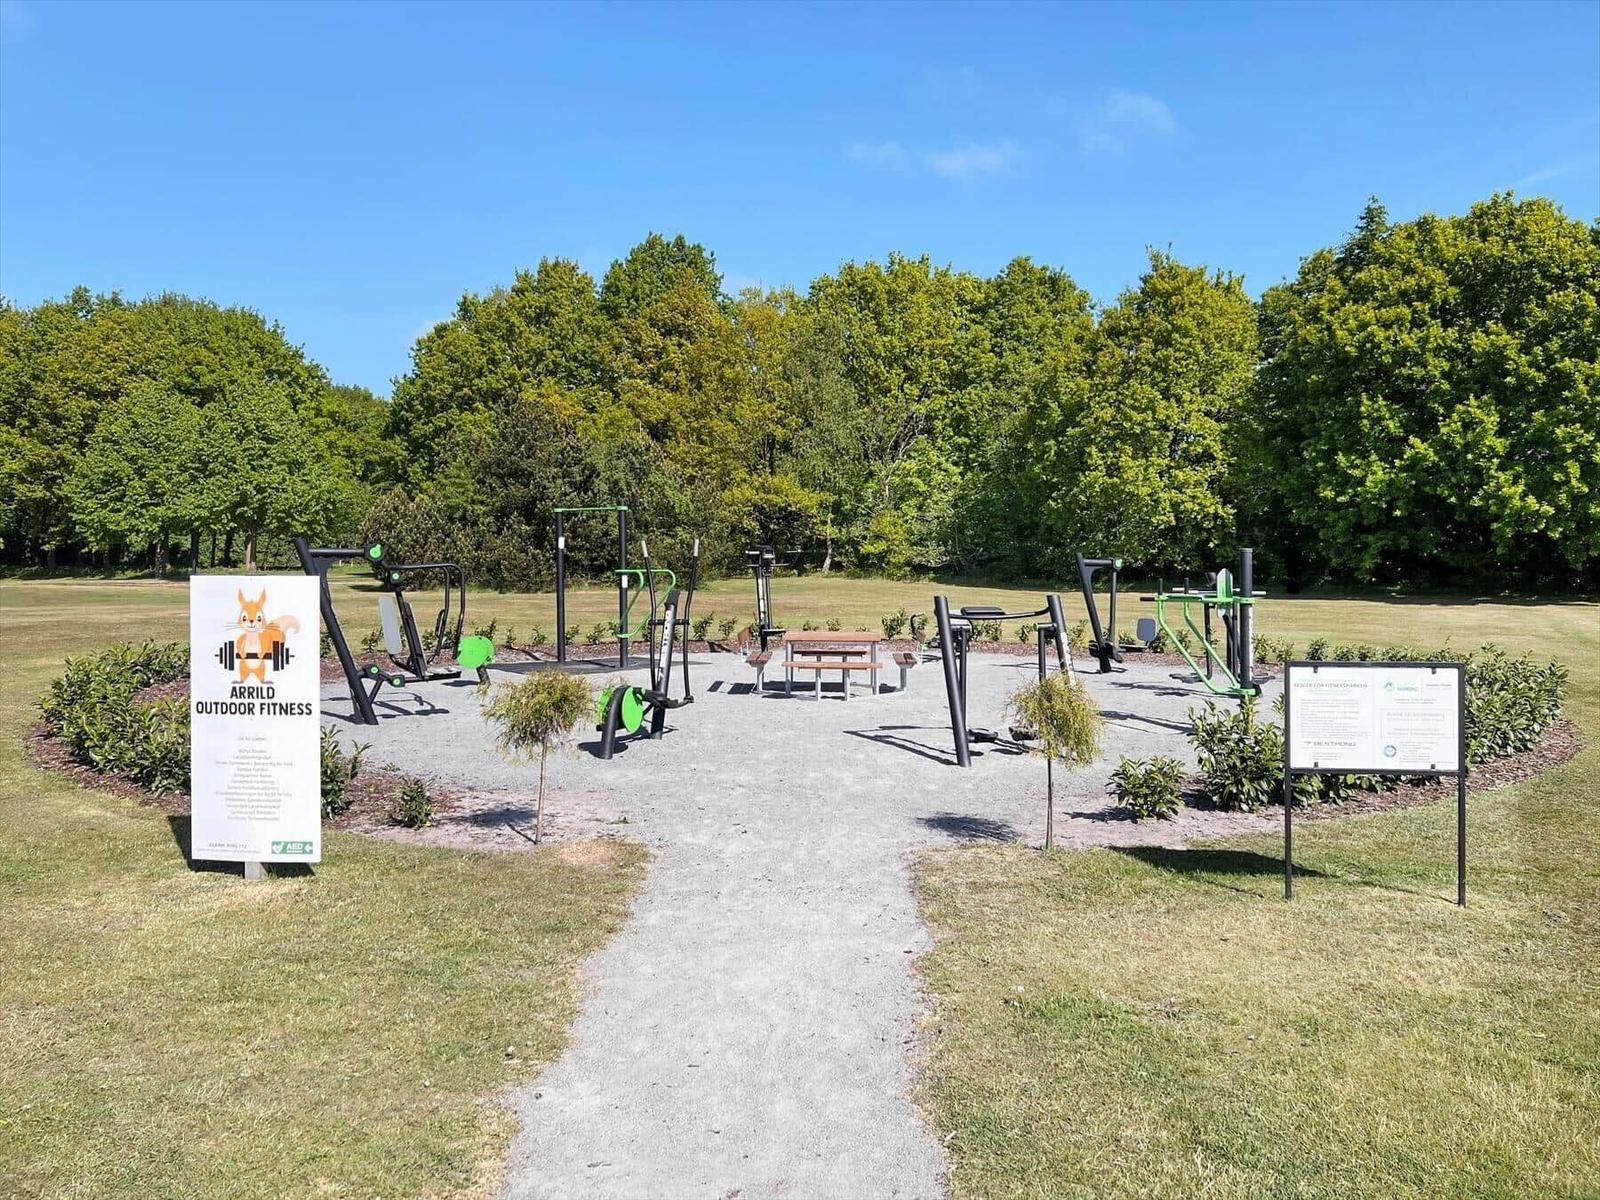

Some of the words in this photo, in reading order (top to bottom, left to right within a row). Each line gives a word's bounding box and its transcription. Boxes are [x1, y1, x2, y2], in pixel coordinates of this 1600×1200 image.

[230, 686, 275, 699] ARRILD
[196, 701, 255, 715] OUTDOOR
[260, 702, 312, 715] FITNESS
[286, 842, 303, 850] AED
